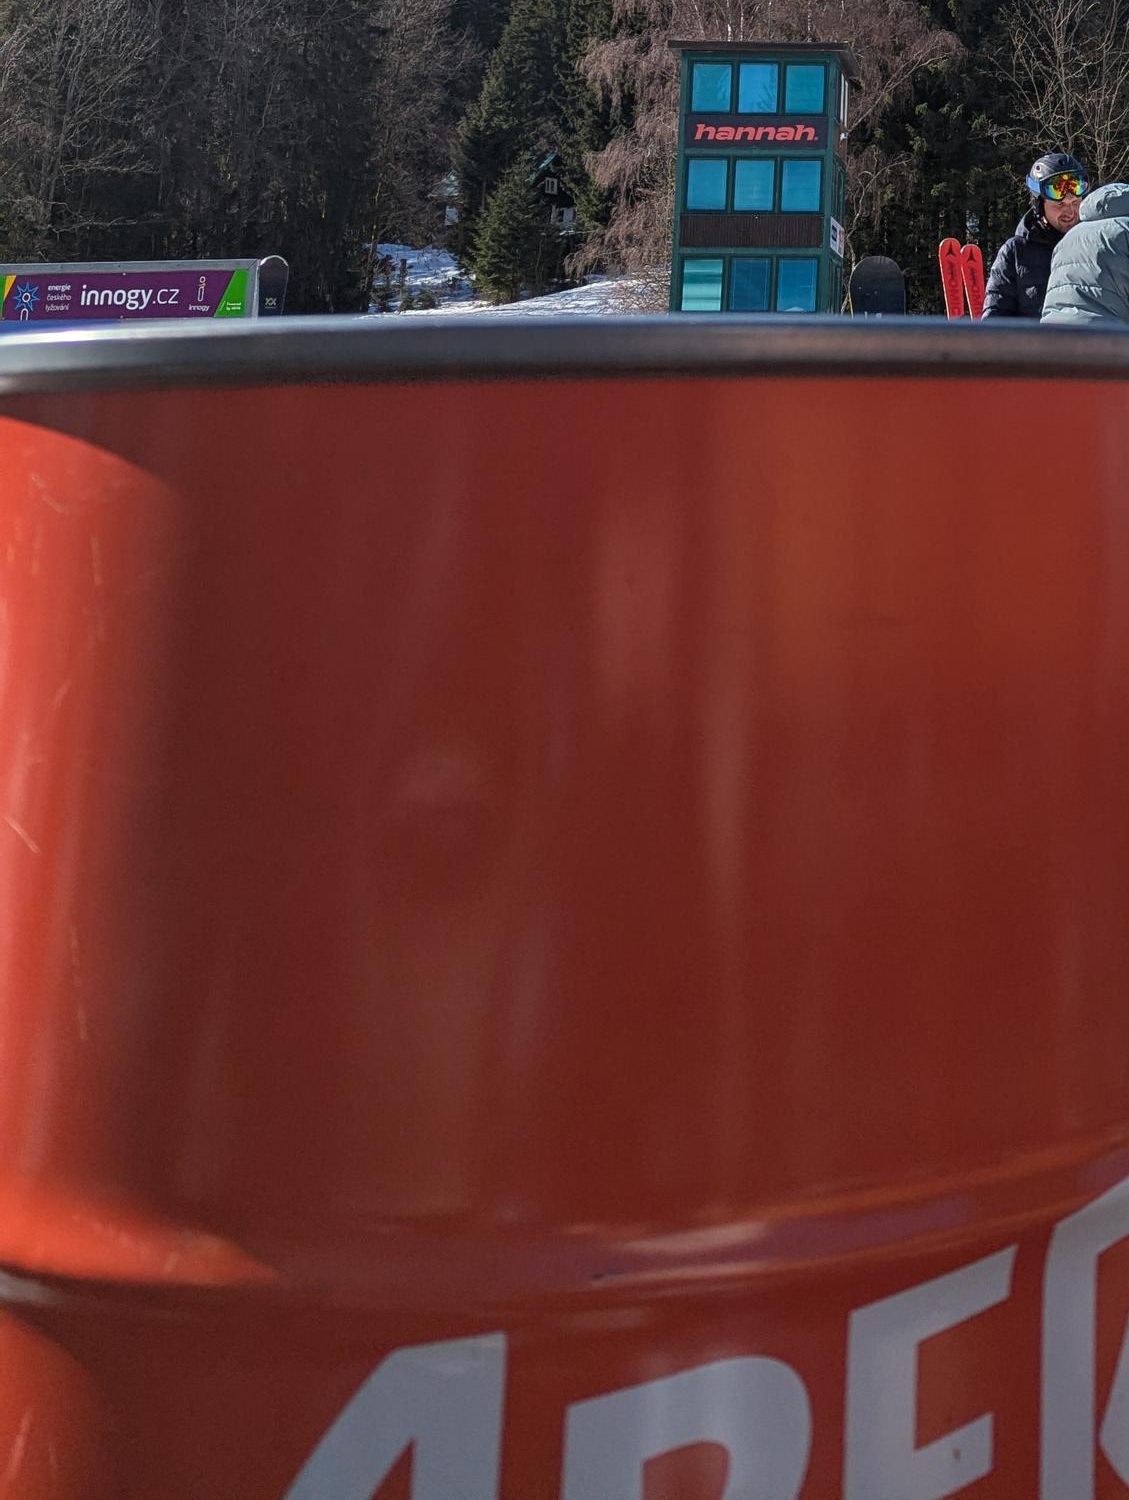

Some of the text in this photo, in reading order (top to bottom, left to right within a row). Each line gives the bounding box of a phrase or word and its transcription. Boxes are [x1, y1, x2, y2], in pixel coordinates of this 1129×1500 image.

[694, 123, 815, 141] hannah
[47, 283, 71, 293] energie
[46, 292, 72, 301] českého
[80, 285, 180, 311] innogy.cz
[45, 303, 70, 313] lyžování
[188, 303, 211, 312] innogy
